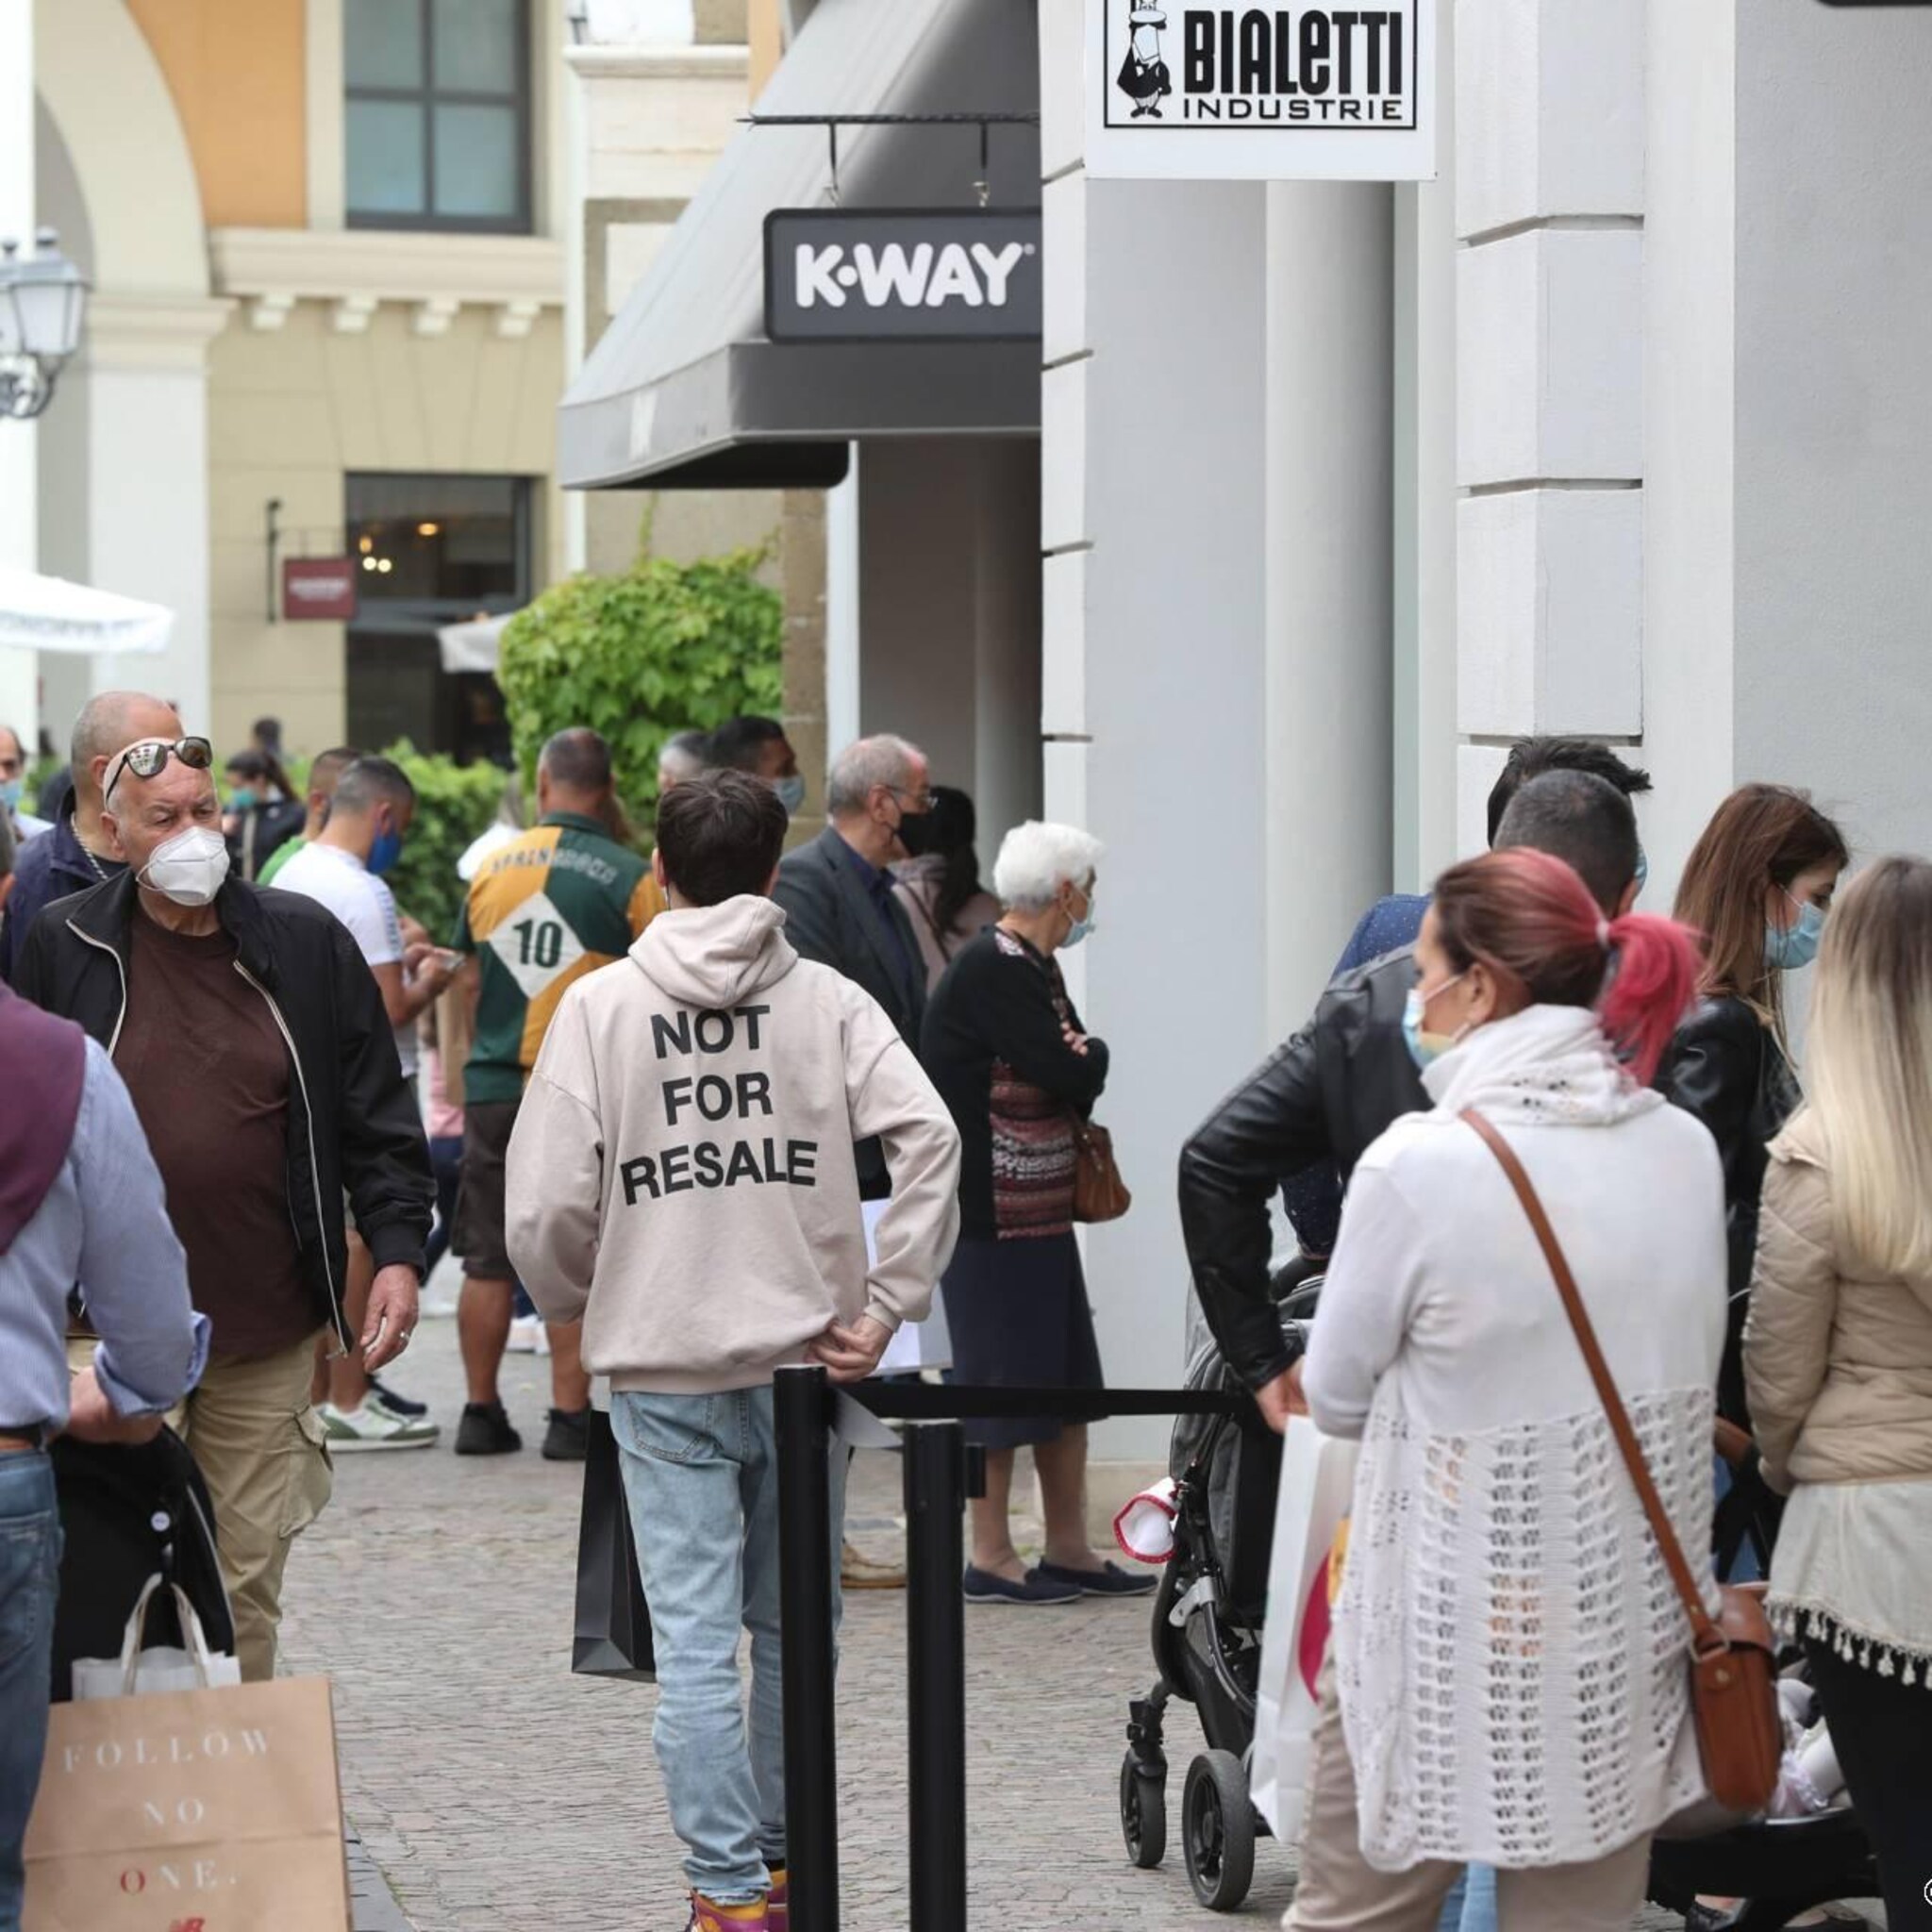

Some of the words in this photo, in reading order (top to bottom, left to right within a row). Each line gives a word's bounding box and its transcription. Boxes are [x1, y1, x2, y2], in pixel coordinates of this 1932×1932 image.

[1183, 98, 1403, 121] INDUSTRIE
[512, 918, 563, 969] 10
[650, 1004, 771, 1059] NOT
[661, 1071, 774, 1126] FOR
[620, 1137, 818, 1207] RESALE
[63, 1728, 268, 1774] FOLLOW
[144, 1797, 205, 1825] NO
[120, 1859, 237, 1894] ONE.
